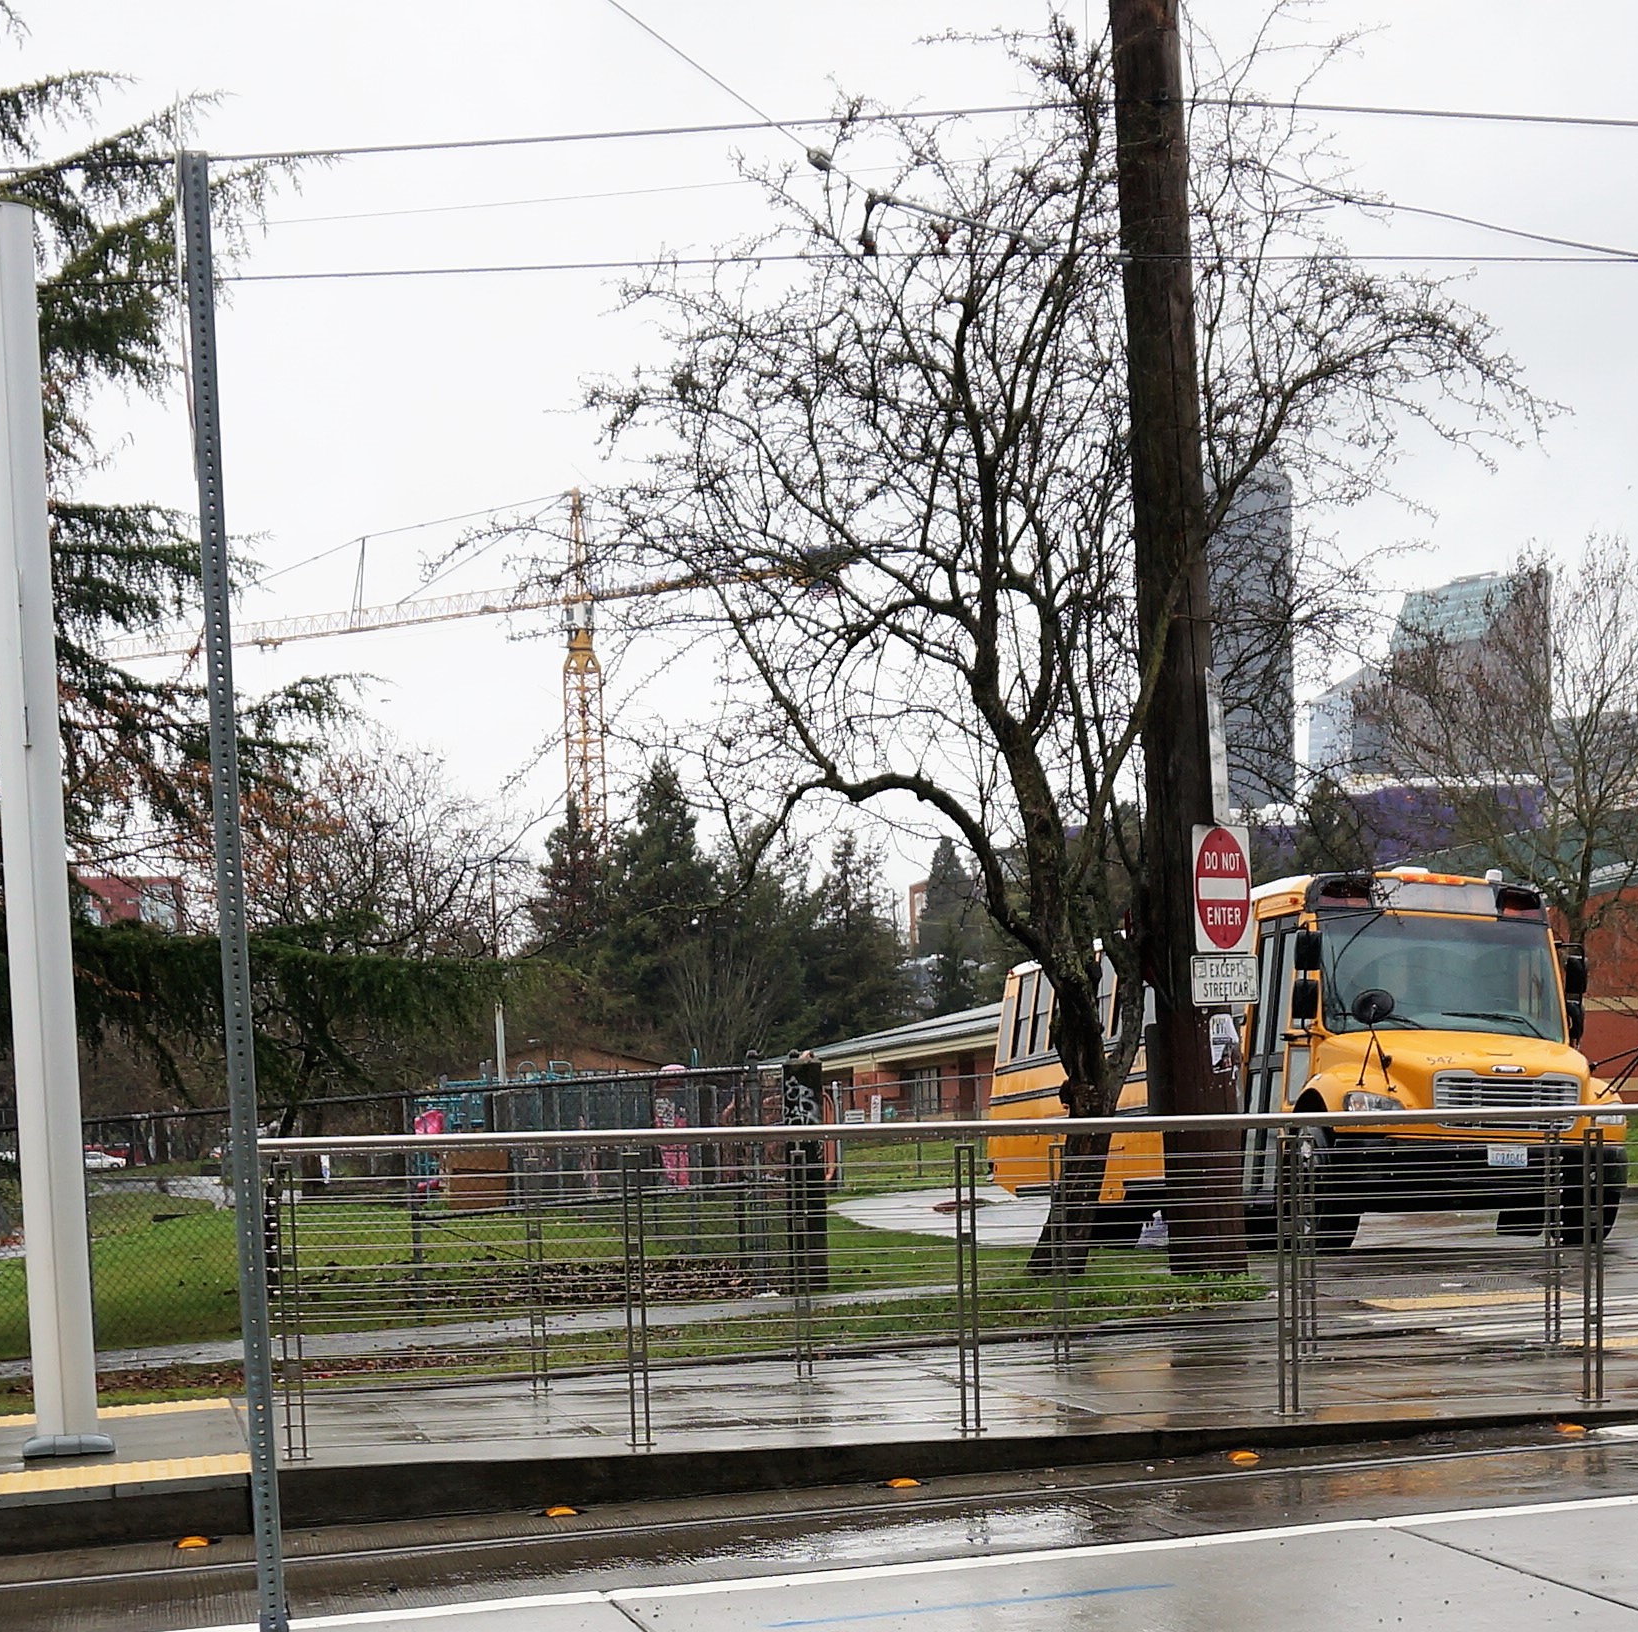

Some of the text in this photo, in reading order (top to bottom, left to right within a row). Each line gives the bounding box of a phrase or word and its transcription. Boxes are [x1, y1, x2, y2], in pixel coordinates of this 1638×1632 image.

[1204, 851, 1240, 871] DO NOT
[1207, 907, 1241, 925] ENTER
[1210, 963, 1241, 978] EXCEPT
[1204, 982, 1248, 997] STREETCAR
